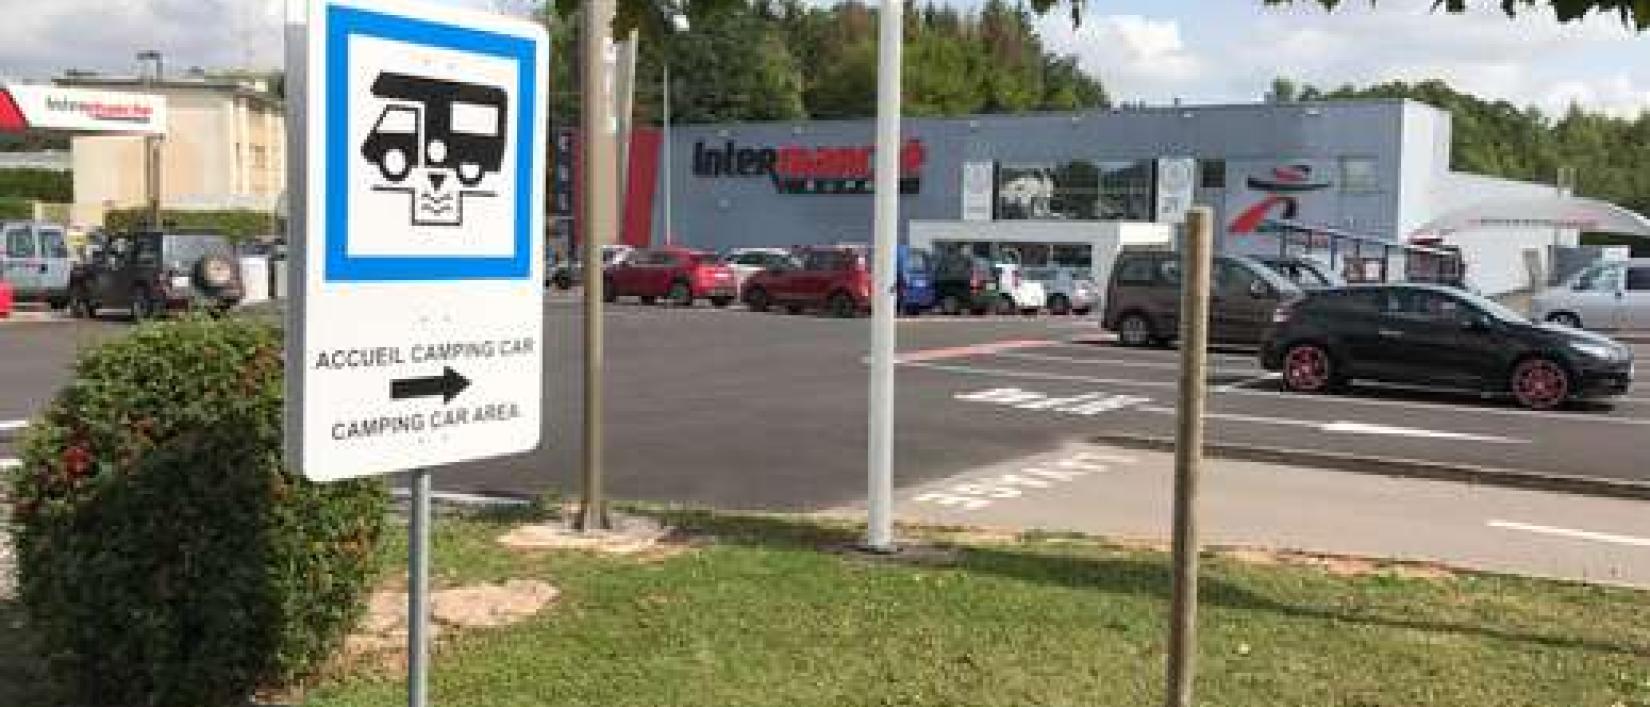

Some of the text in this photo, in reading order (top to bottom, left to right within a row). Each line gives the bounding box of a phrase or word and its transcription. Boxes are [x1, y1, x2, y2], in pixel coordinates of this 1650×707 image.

[315, 336, 535, 370] ACCUEIL CAMPING CAR
[331, 403, 521, 440] CAMPING CAR AREA
